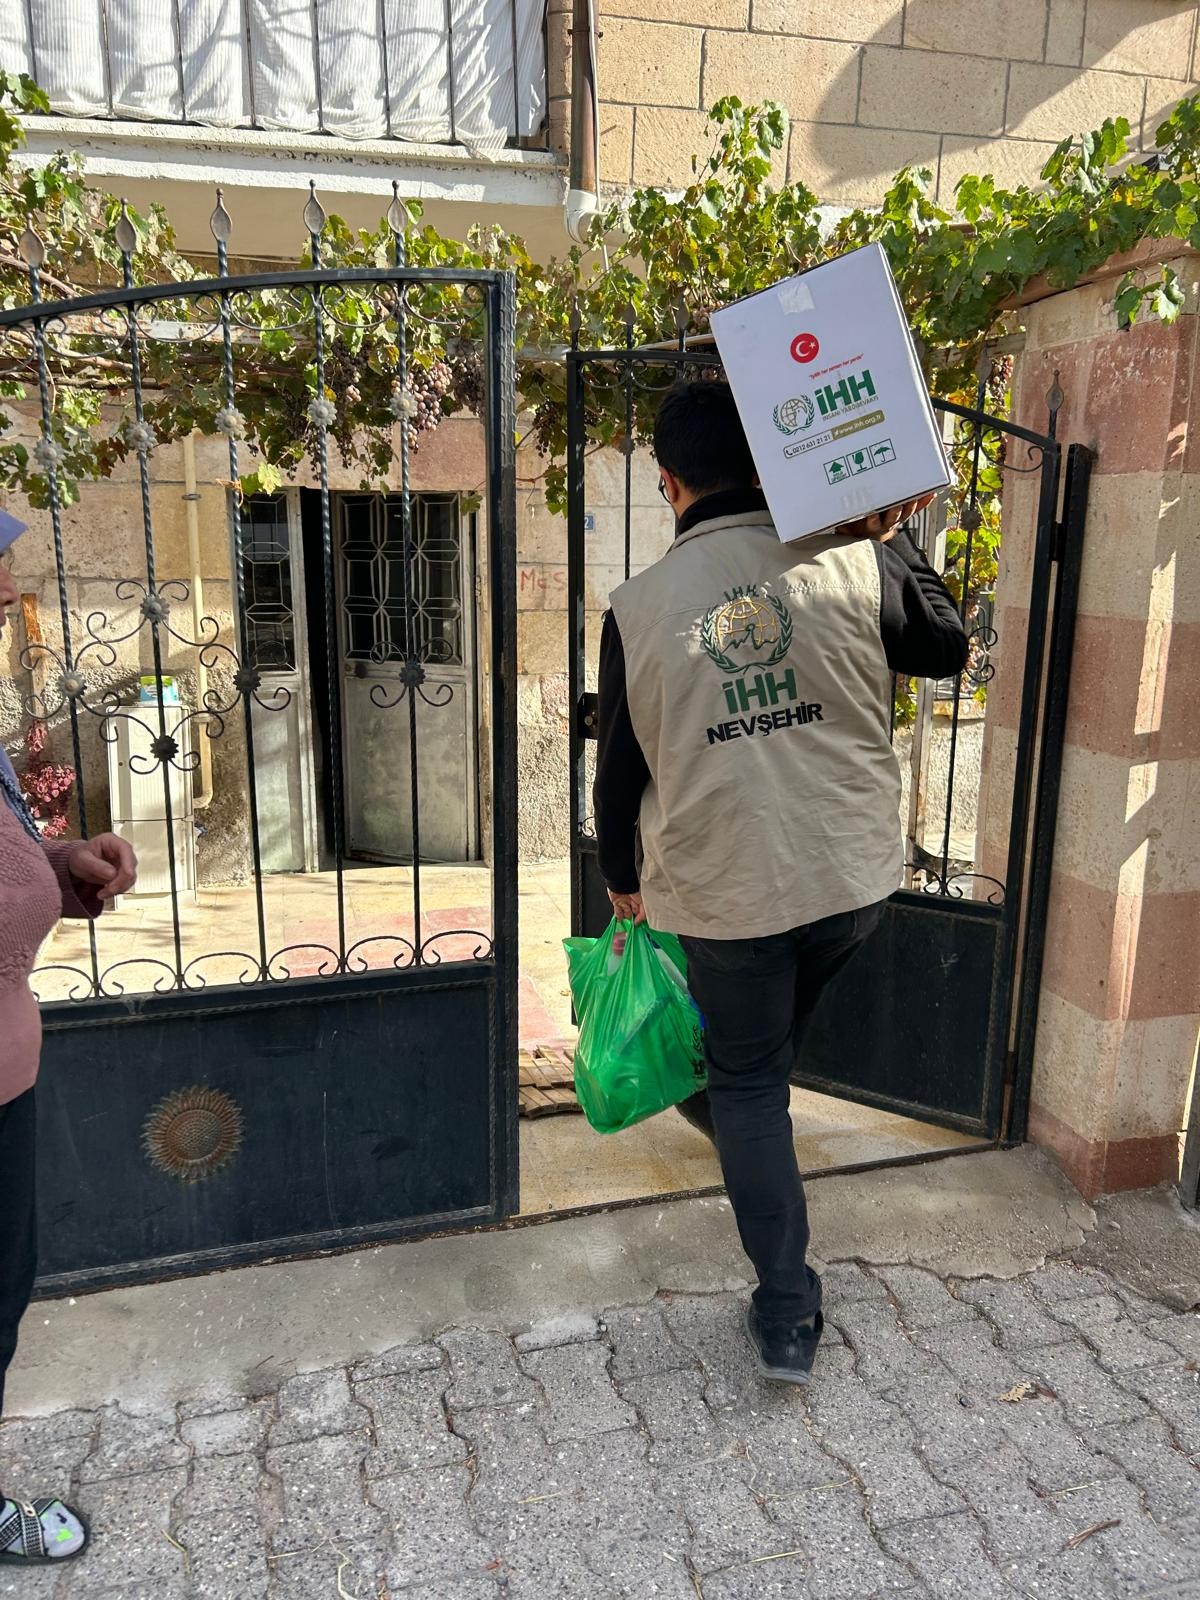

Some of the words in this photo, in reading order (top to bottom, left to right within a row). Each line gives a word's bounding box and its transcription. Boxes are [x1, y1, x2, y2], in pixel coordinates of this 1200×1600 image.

[792, 444, 806, 453] 0212
[805, 440, 815, 448] 631
[816, 436, 823, 444] 21
[706, 701, 824, 745] NEVŞEHİR
